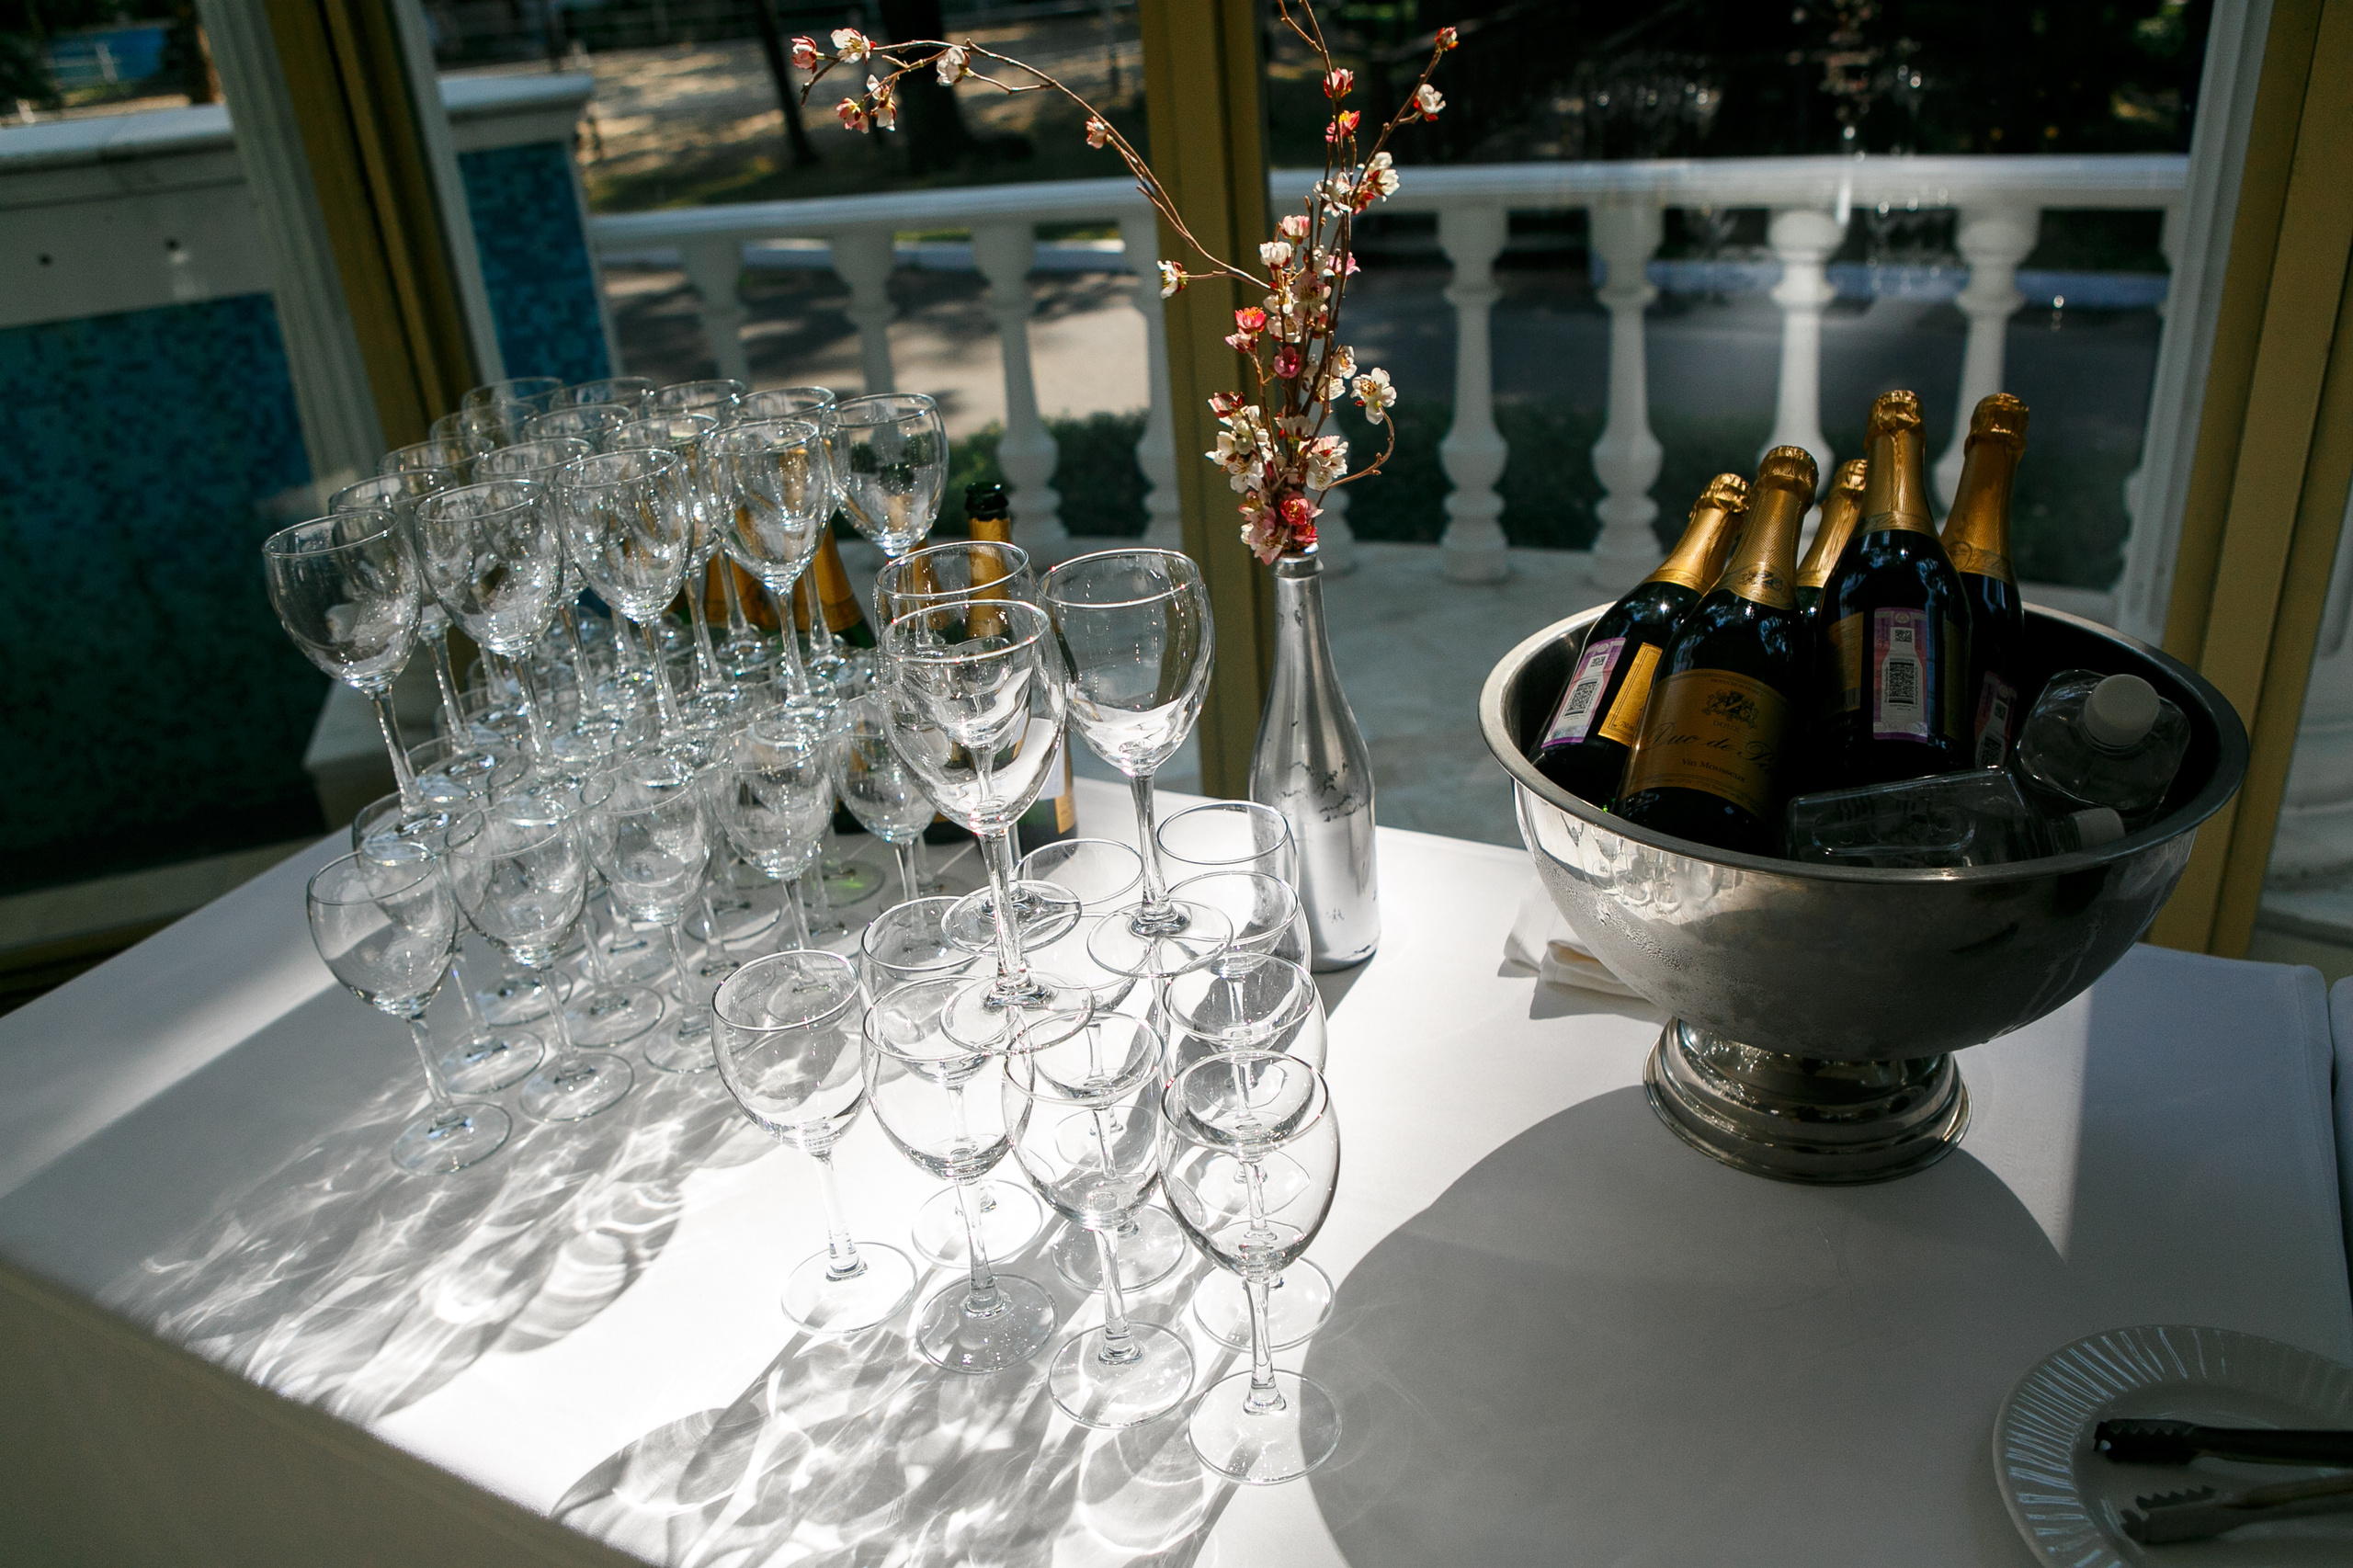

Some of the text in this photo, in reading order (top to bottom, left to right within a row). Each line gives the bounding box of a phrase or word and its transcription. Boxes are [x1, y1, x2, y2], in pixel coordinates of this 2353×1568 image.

[1712, 720, 1740, 733] DOUX
[1702, 737, 1735, 752] de
[1682, 758, 1746, 783] Vin Mousseux
